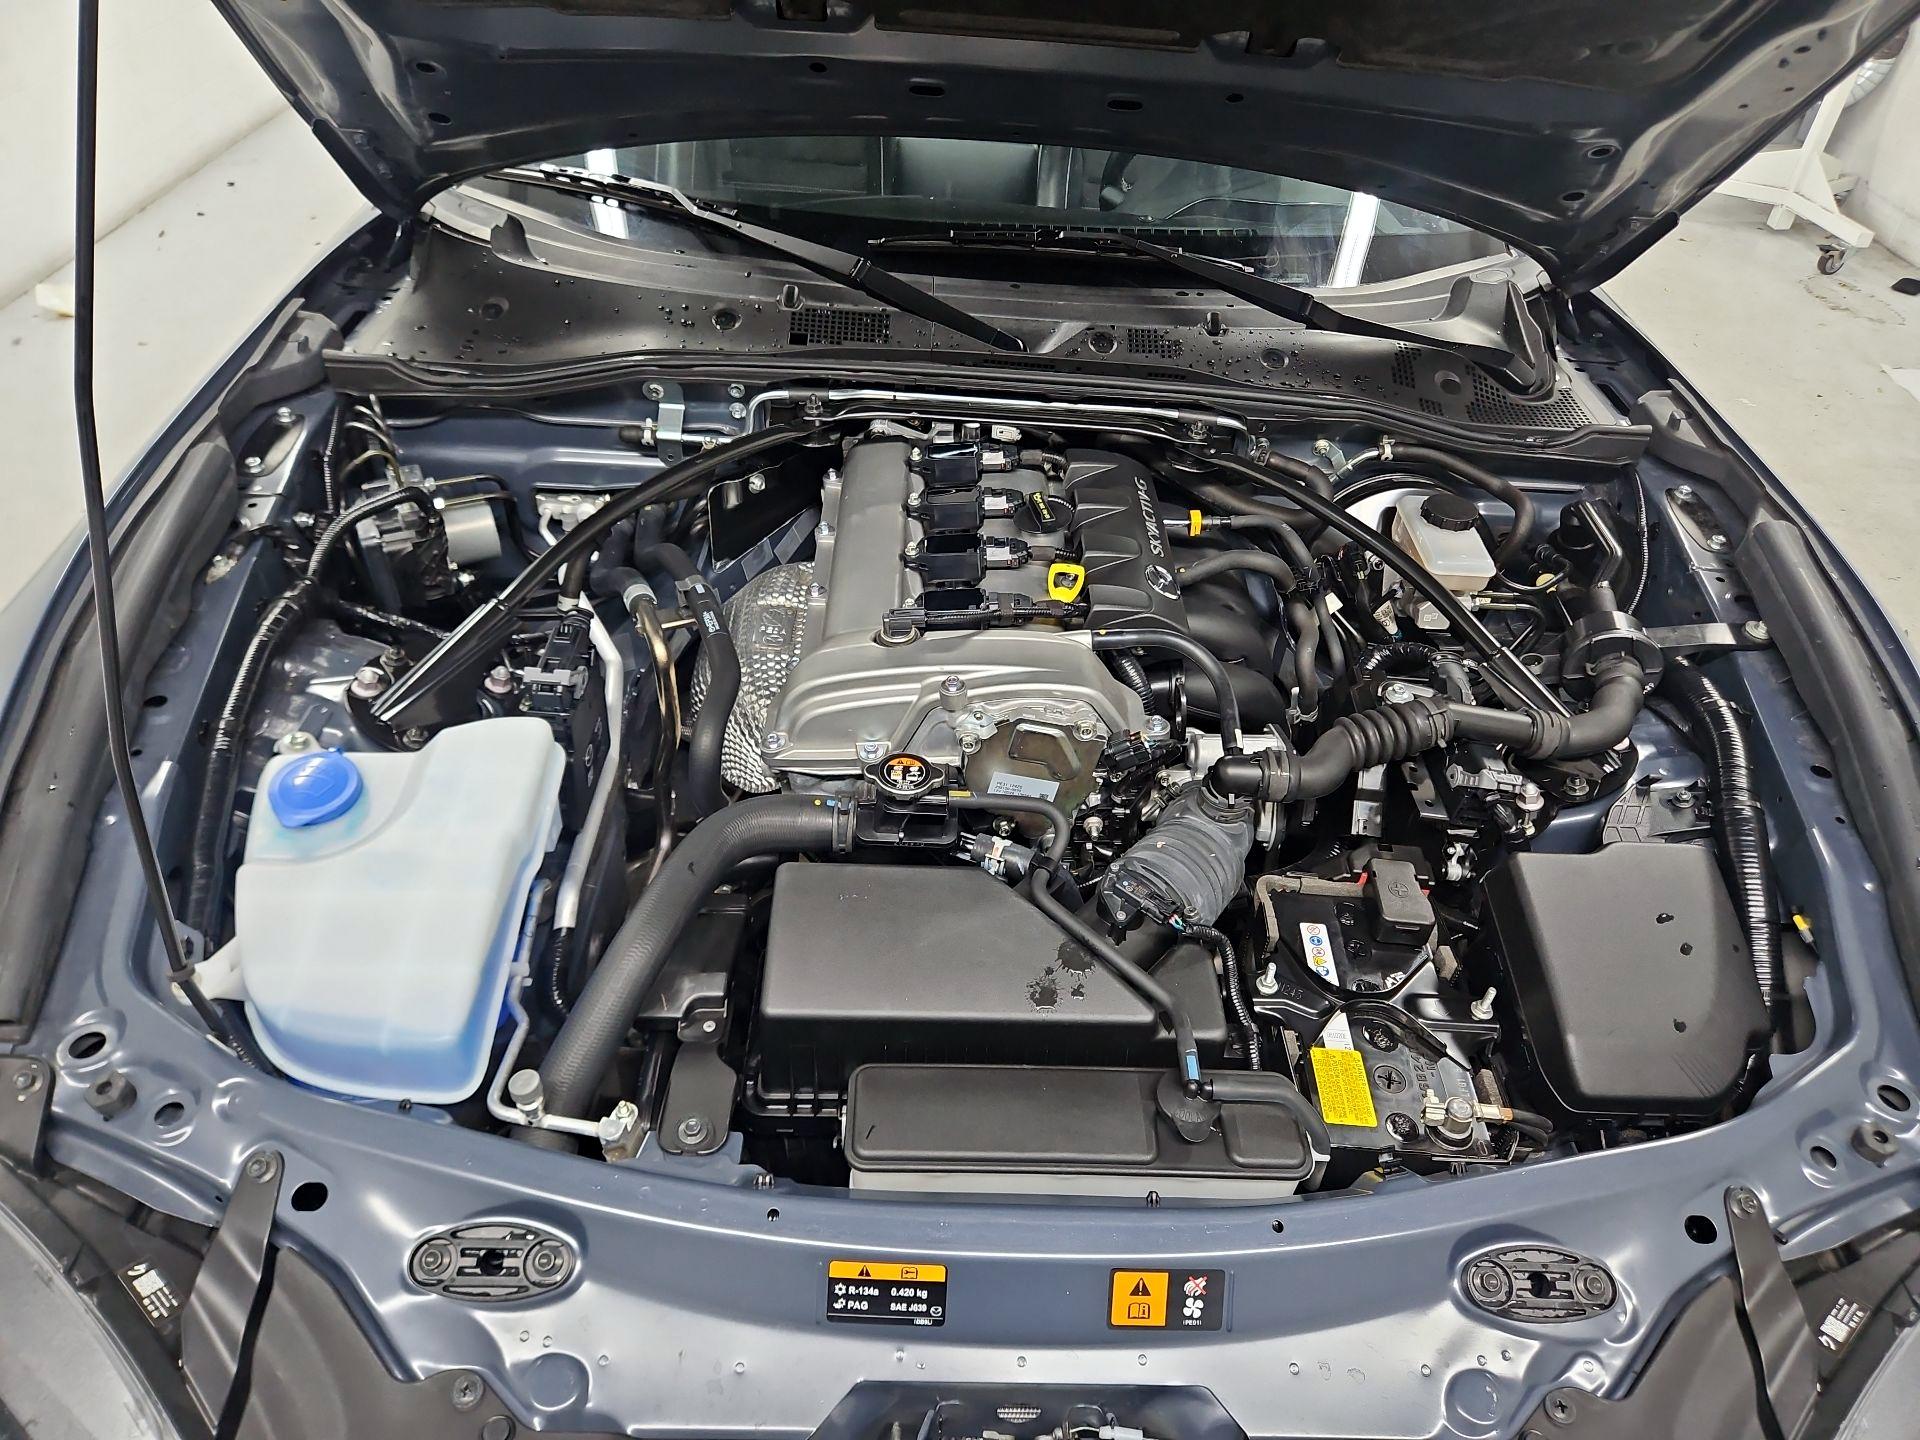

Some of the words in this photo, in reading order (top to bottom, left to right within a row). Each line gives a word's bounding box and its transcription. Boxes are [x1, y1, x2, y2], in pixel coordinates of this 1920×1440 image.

[1134, 476, 1164, 558] SKYACTIV-G
[848, 1285, 879, 1296] R-134a
[890, 1287, 915, 1297] 0.420
[916, 1288, 928, 1299] kg
[847, 1300, 869, 1310] PAG
[889, 1302, 907, 1311] SAE
[908, 1303, 927, 1312] J639
